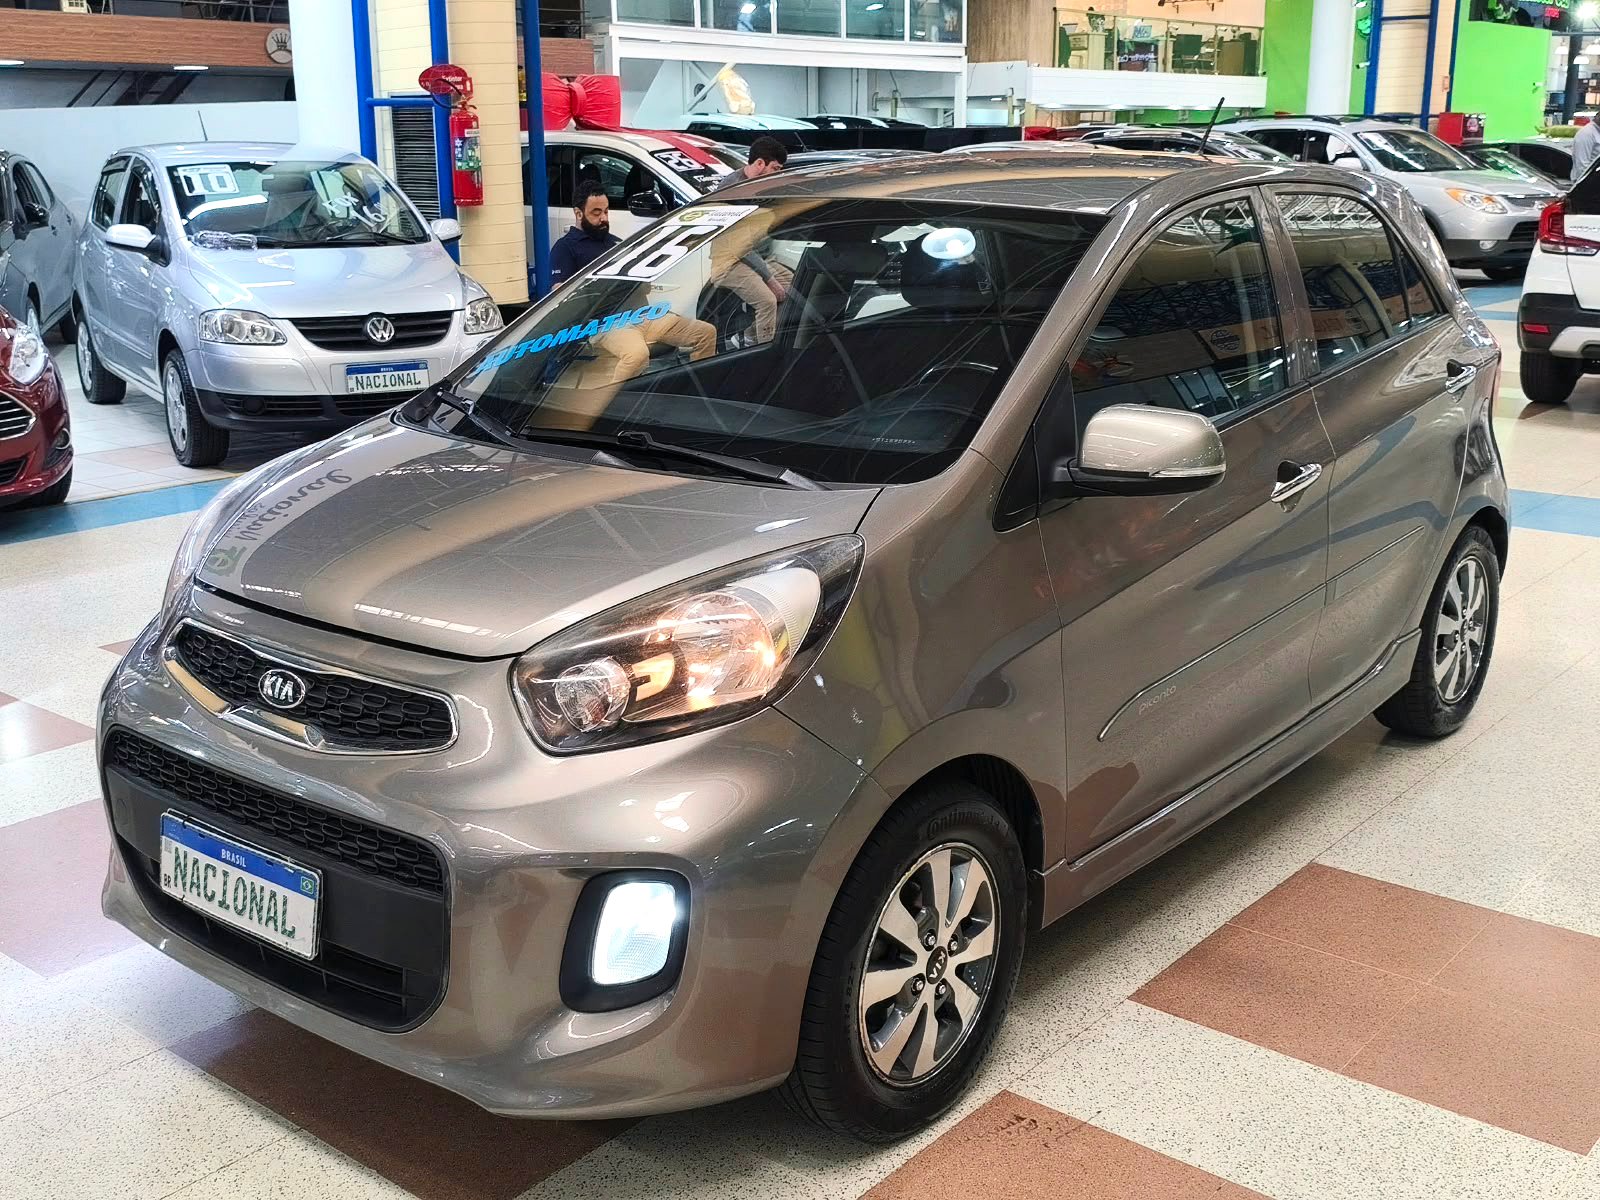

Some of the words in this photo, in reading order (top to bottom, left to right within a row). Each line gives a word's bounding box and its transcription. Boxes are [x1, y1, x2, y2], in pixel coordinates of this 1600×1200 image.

[184, 172, 233, 193] 10
[596, 225, 724, 278] 16
[355, 373, 421, 391] NACIONAL
[262, 673, 295, 703] KIA
[221, 849, 247, 868] BRASIL
[163, 873, 172, 889] BR
[174, 846, 296, 939] NACIONAL
[928, 950, 946, 979] KIA
